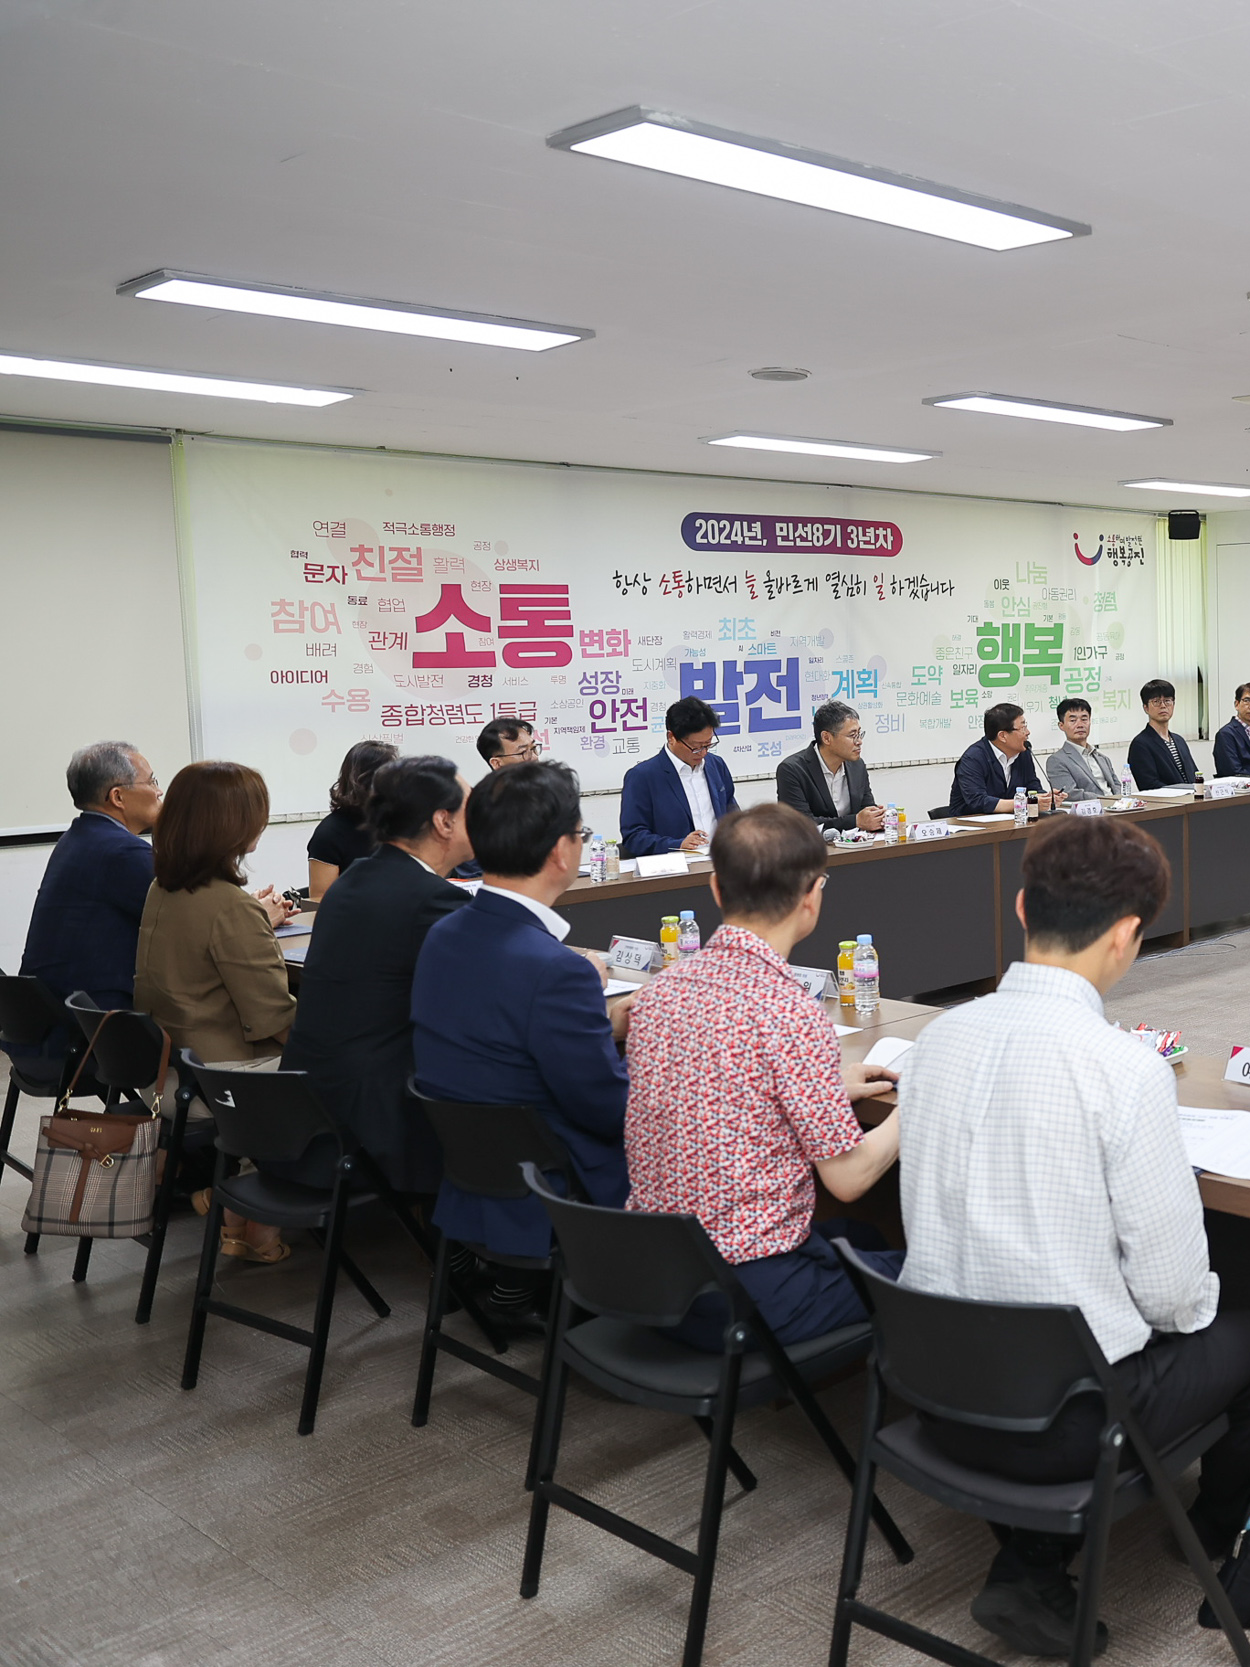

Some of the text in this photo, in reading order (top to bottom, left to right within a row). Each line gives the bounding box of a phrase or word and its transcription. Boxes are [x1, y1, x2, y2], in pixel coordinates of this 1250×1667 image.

[312, 520, 346, 538] 연결
[382, 521, 456, 537] 적극소통행정
[694, 518, 894, 550] 2024년, 민선8기 3년차
[349, 544, 424, 583] 친절
[433, 556, 465, 575] 활력
[493, 558, 540, 572] 상생복지
[1106, 546, 1145, 568] 행복광진
[303, 562, 348, 585] 문자
[1016, 561, 1048, 585] 나눔
[470, 580, 492, 592] 현장
[612, 569, 956, 602] 항상 소통하면서 늘 올바르게 열심히 일 하겠습니다
[993, 578, 1010, 591] 이웃
[347, 595, 368, 606] 동료
[1041, 587, 1077, 602] 아동권리
[1093, 591, 1118, 612] 청렴
[377, 597, 406, 613] 협업
[1001, 595, 1031, 618] 안심
[270, 598, 342, 635] 참여
[412, 583, 574, 669] 소통
[682, 629, 713, 640] 활력경제
[717, 616, 757, 642] 최초
[368, 631, 408, 651] 관계
[579, 628, 632, 659] 변화
[637, 635, 663, 646] 새단장
[747, 642, 777, 656] 스마트
[790, 635, 825, 648] 지역개발
[305, 643, 337, 657] 배려
[684, 647, 707, 658] 가능성
[936, 646, 973, 661] 좋은친구
[976, 621, 1064, 688] 행복
[1073, 645, 1108, 661] 1인가구
[353, 663, 374, 675] 경험
[632, 657, 677, 672] 도시계획
[952, 663, 978, 676] 일자리
[270, 670, 329, 684] 아이디어
[393, 674, 444, 688] 도시발전
[467, 674, 493, 688] 경청
[502, 676, 529, 687] 서비스
[578, 670, 622, 696] 성장
[831, 668, 878, 699] 계획
[910, 665, 943, 686] 도약
[1063, 665, 1102, 694] 공정
[321, 688, 371, 713] 수용
[550, 698, 584, 710] 소상공인
[679, 656, 802, 736] 발전
[896, 690, 942, 707] 문화예술
[950, 688, 979, 709] 보육
[1102, 688, 1132, 711] 복지
[380, 701, 538, 727] 종합청렴도 1등급
[589, 697, 648, 734] 안전
[875, 712, 905, 734] 정비
[919, 717, 952, 730] 복합개발
[580, 735, 606, 752] 환경
[612, 736, 641, 755] 교통
[757, 740, 782, 758] 조성
